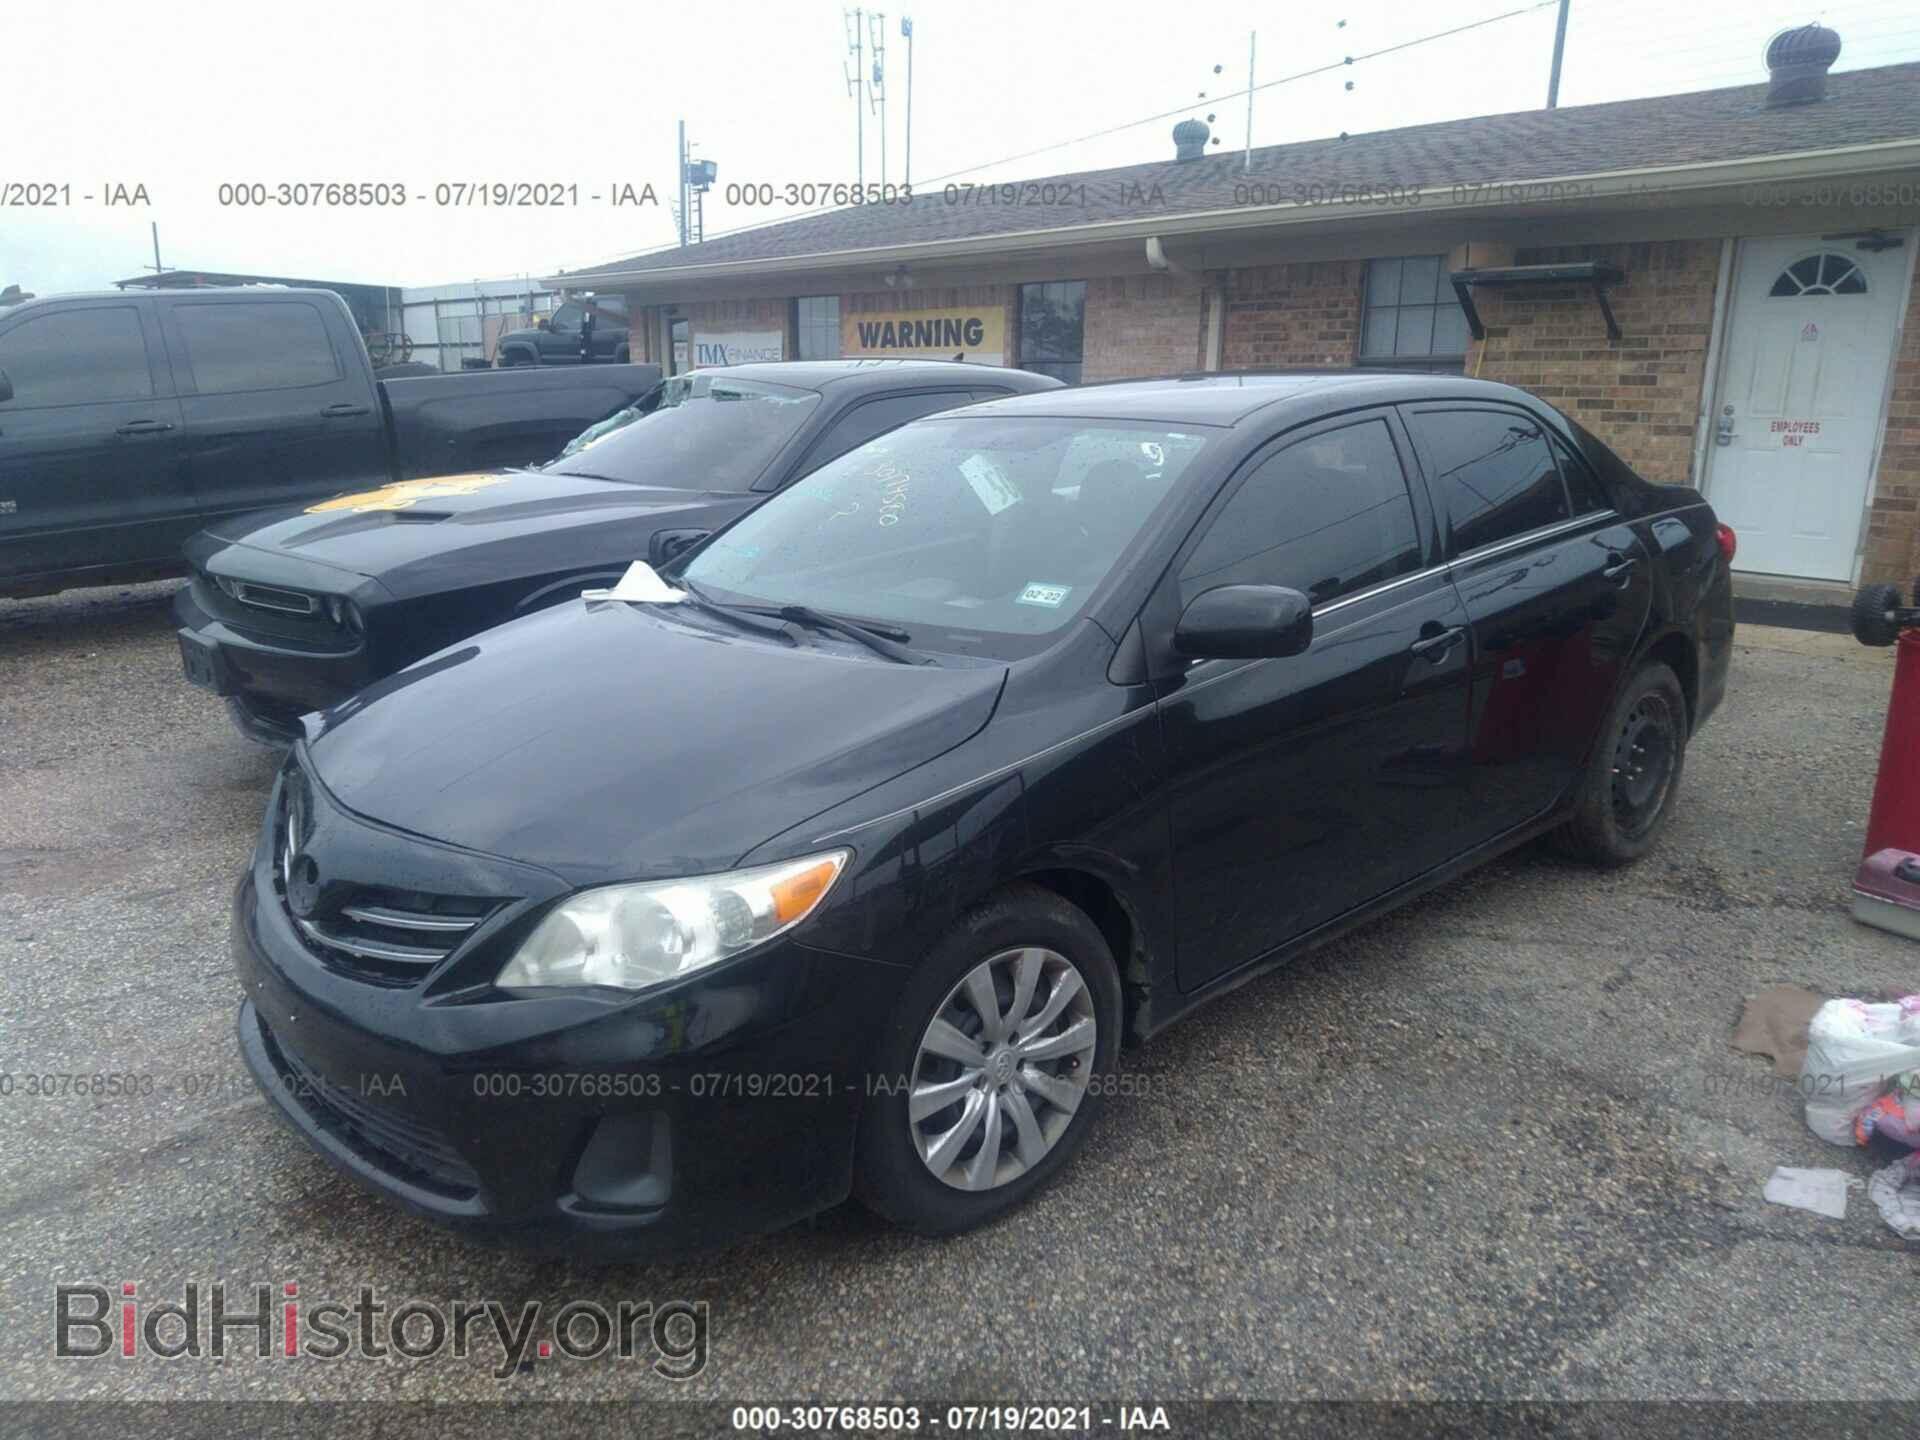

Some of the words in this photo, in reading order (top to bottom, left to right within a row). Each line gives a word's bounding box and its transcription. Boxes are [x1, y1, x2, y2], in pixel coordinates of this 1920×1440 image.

[857, 317, 985, 350] WARNING
[696, 343, 728, 366] TMX
[1770, 420, 1821, 434] EMPLOYEES
[1782, 434, 1805, 447] ONLY
